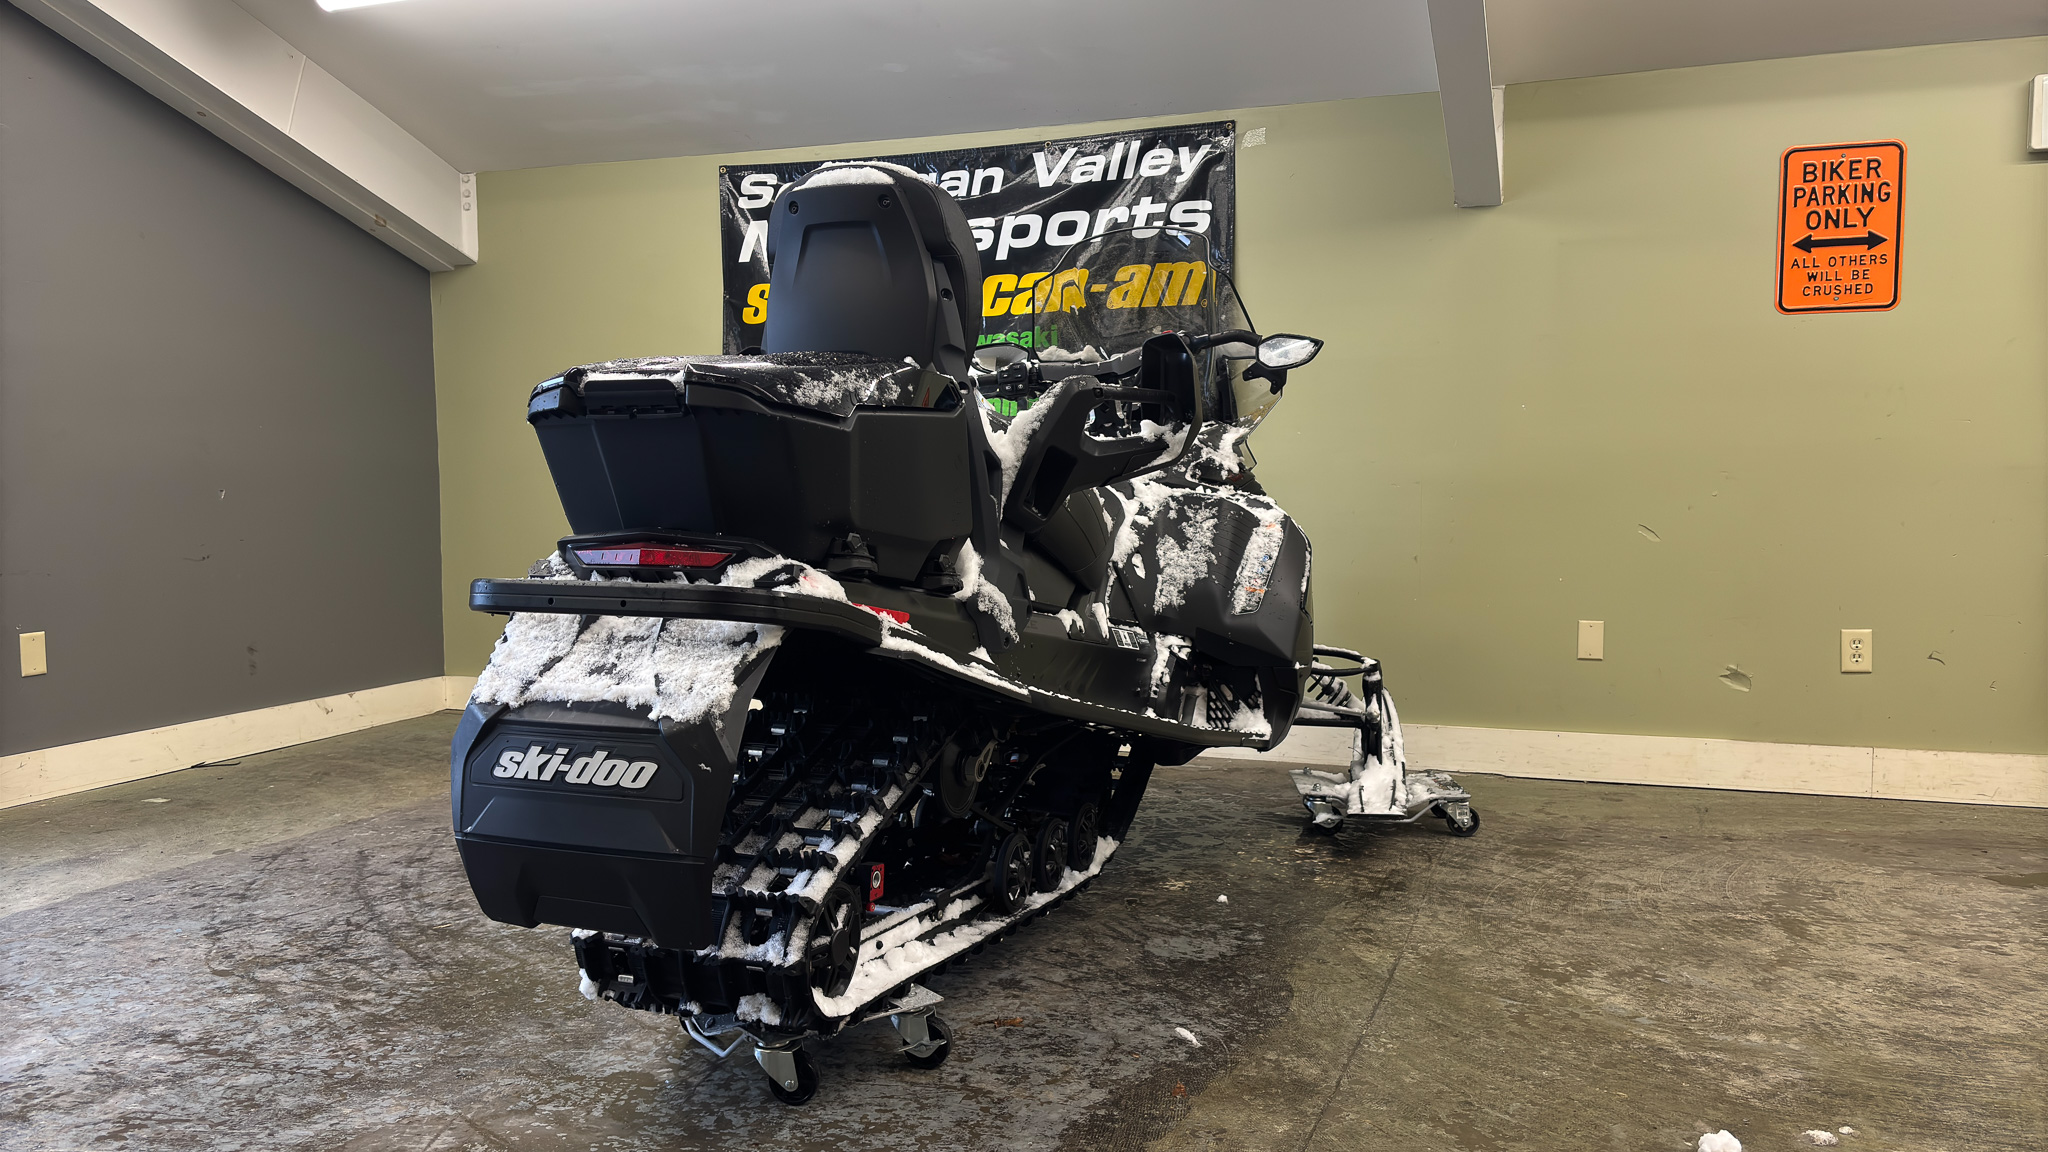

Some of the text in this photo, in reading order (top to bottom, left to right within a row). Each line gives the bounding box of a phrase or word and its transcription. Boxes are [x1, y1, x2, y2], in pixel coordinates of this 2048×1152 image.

[1032, 140, 1212, 188] Valley
[1802, 158, 1882, 183] BIKER
[1793, 181, 1892, 208] PARKING
[1805, 206, 1876, 230] ONLY
[1790, 253, 1888, 269] ALL OTHERS
[1806, 269, 1870, 282] WILL BE
[981, 260, 1207, 317] can-am
[1802, 283, 1874, 296] CRUSHED
[976, 324, 1058, 348] wasaki
[493, 745, 659, 789] ski-doo
